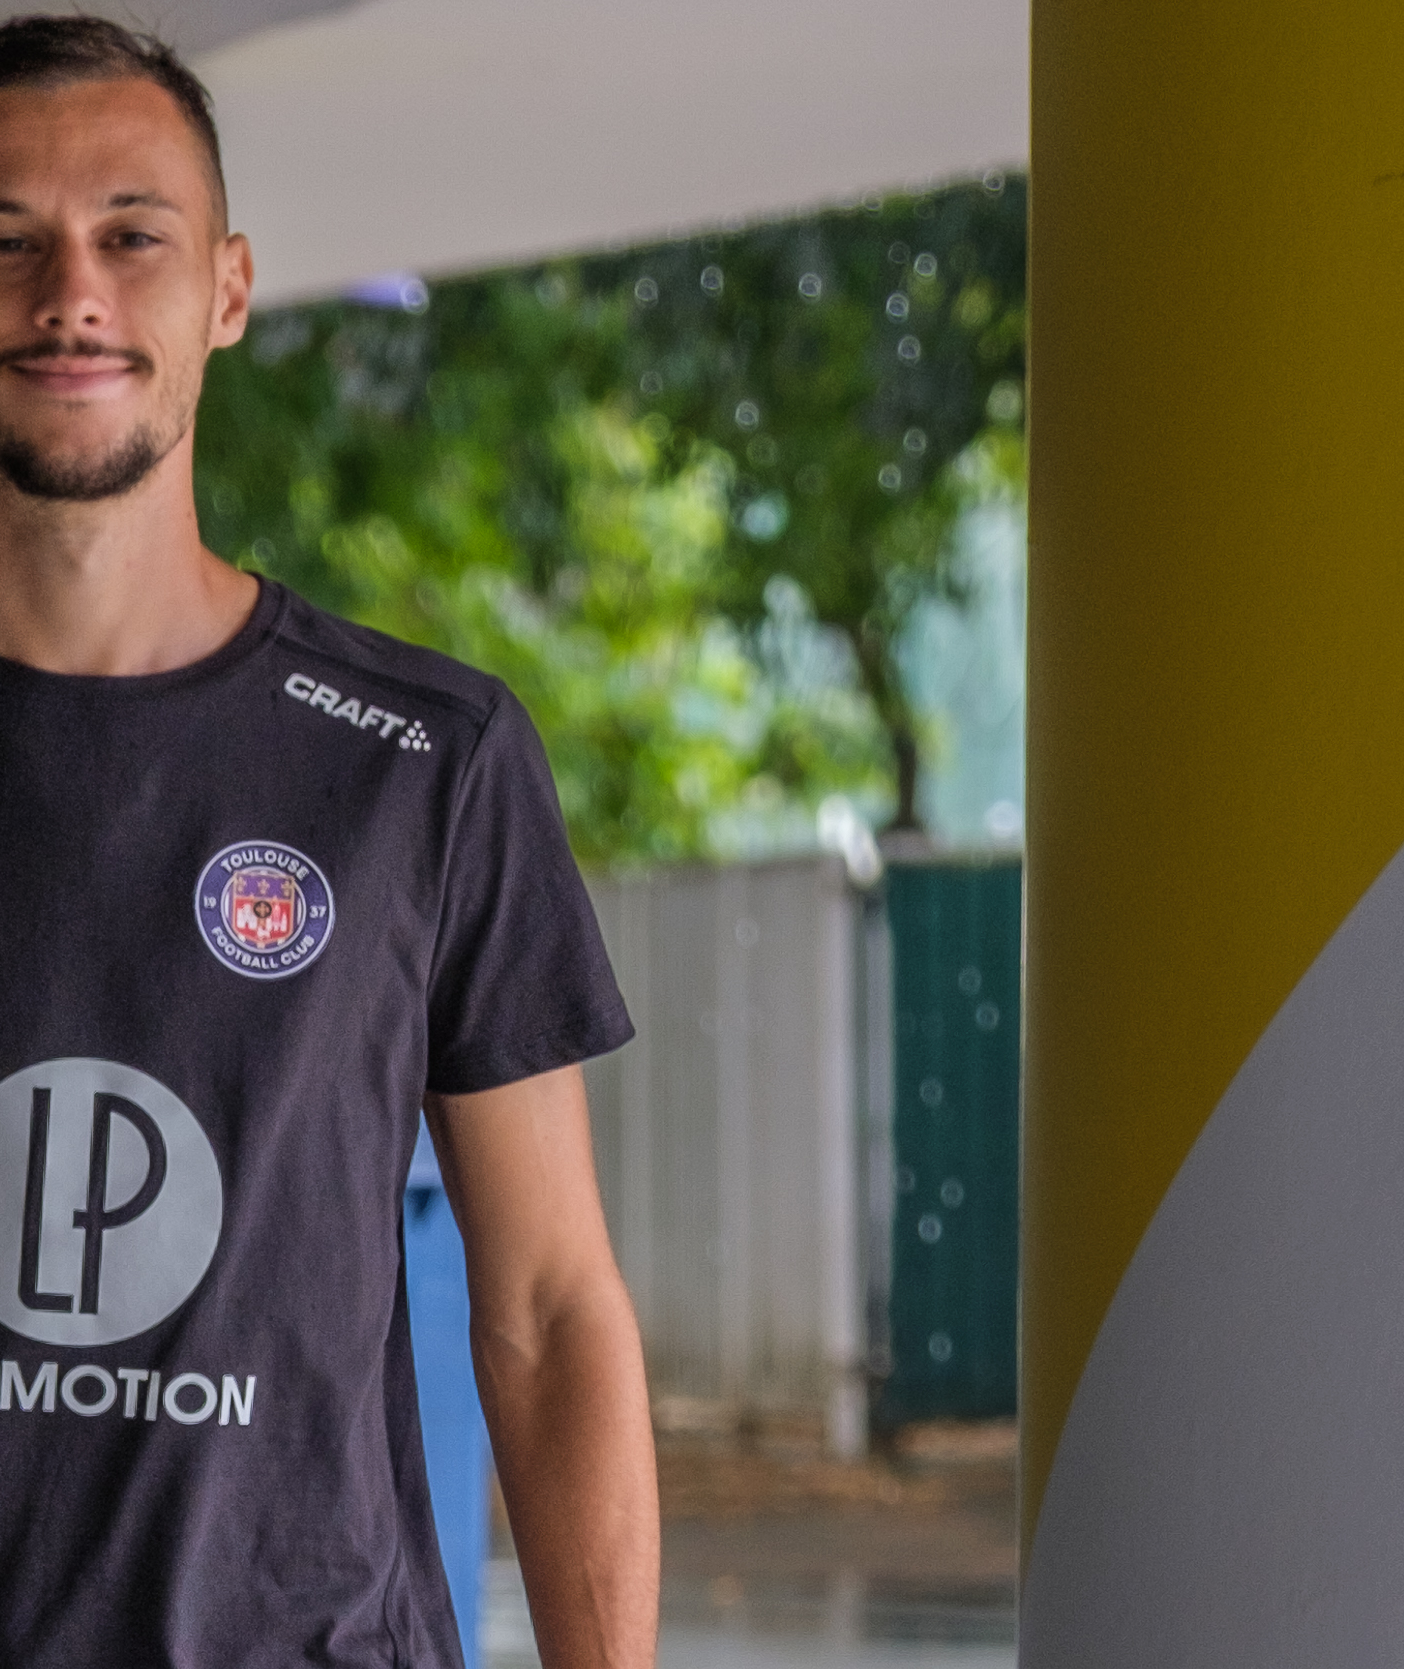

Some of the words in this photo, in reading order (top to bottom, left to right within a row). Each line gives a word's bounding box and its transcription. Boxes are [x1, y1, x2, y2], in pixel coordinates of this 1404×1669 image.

[284, 672, 408, 739] CRAFT
[220, 850, 310, 882] TOULOUSE
[203, 896, 217, 909] 19
[309, 905, 327, 919] 37
[211, 926, 279, 970] FOOTBALL
[280, 934, 316, 966] CLUB
[17, 1086, 168, 1315] LP
